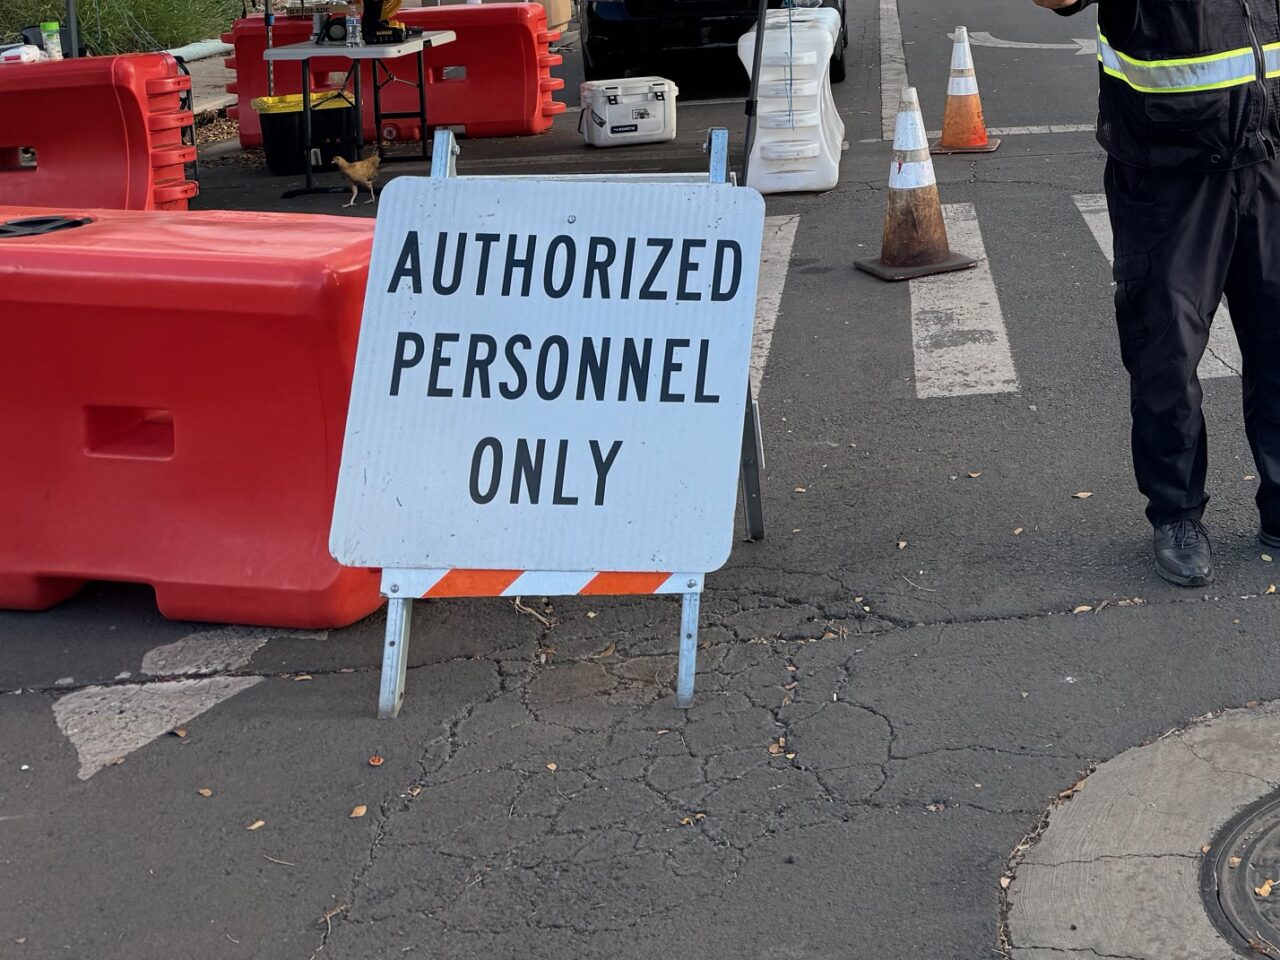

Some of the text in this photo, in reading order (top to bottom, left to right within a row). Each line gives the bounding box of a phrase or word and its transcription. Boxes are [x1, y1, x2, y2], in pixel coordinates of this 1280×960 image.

[387, 230, 743, 302] AUTHORIZED
[389, 331, 720, 403] PERSONNEL
[468, 437, 623, 506] ONLY
